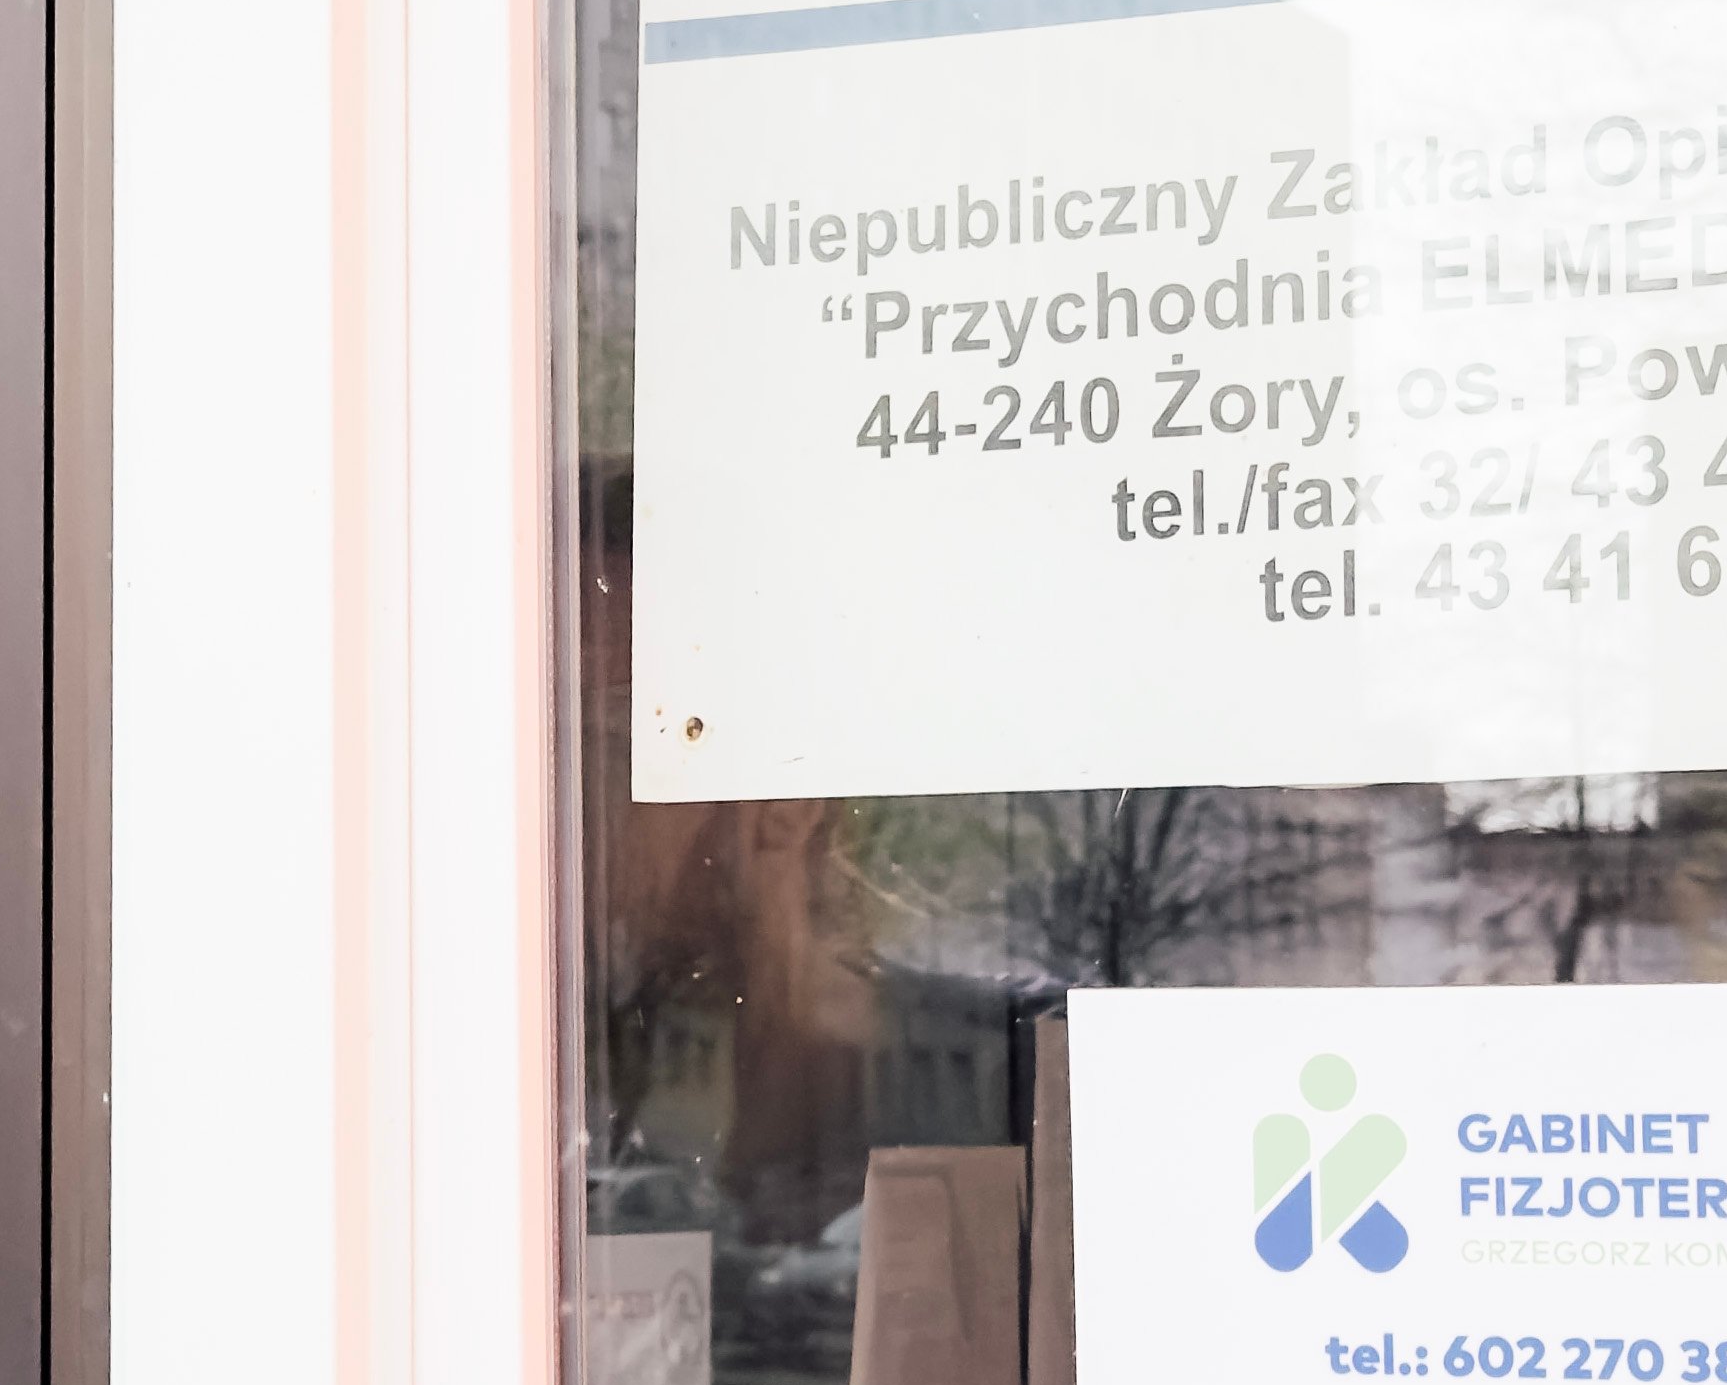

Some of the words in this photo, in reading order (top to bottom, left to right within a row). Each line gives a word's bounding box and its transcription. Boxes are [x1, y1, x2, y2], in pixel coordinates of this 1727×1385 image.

[730, 174, 1239, 277] Niepubliczny
[1267, 124, 1547, 220] Zakład
[855, 376, 1121, 460] 44-240
[1151, 368, 1360, 448] Żory,
[1399, 363, 1524, 418] os.
[1110, 461, 1381, 543] tel./fax
[1420, 449, 1540, 517] 32/
[1570, 434, 1670, 508] 43
[1258, 548, 1381, 624] tel.
[1414, 541, 1510, 611] 43
[1543, 531, 1630, 604] 41
[1457, 1113, 1710, 1154] GABINET
[1460, 1237, 1652, 1270] GRZEGORZ
[1324, 1332, 1429, 1377] tel.:
[1443, 1335, 1547, 1379] 602
[1561, 1337, 1665, 1382] 270
